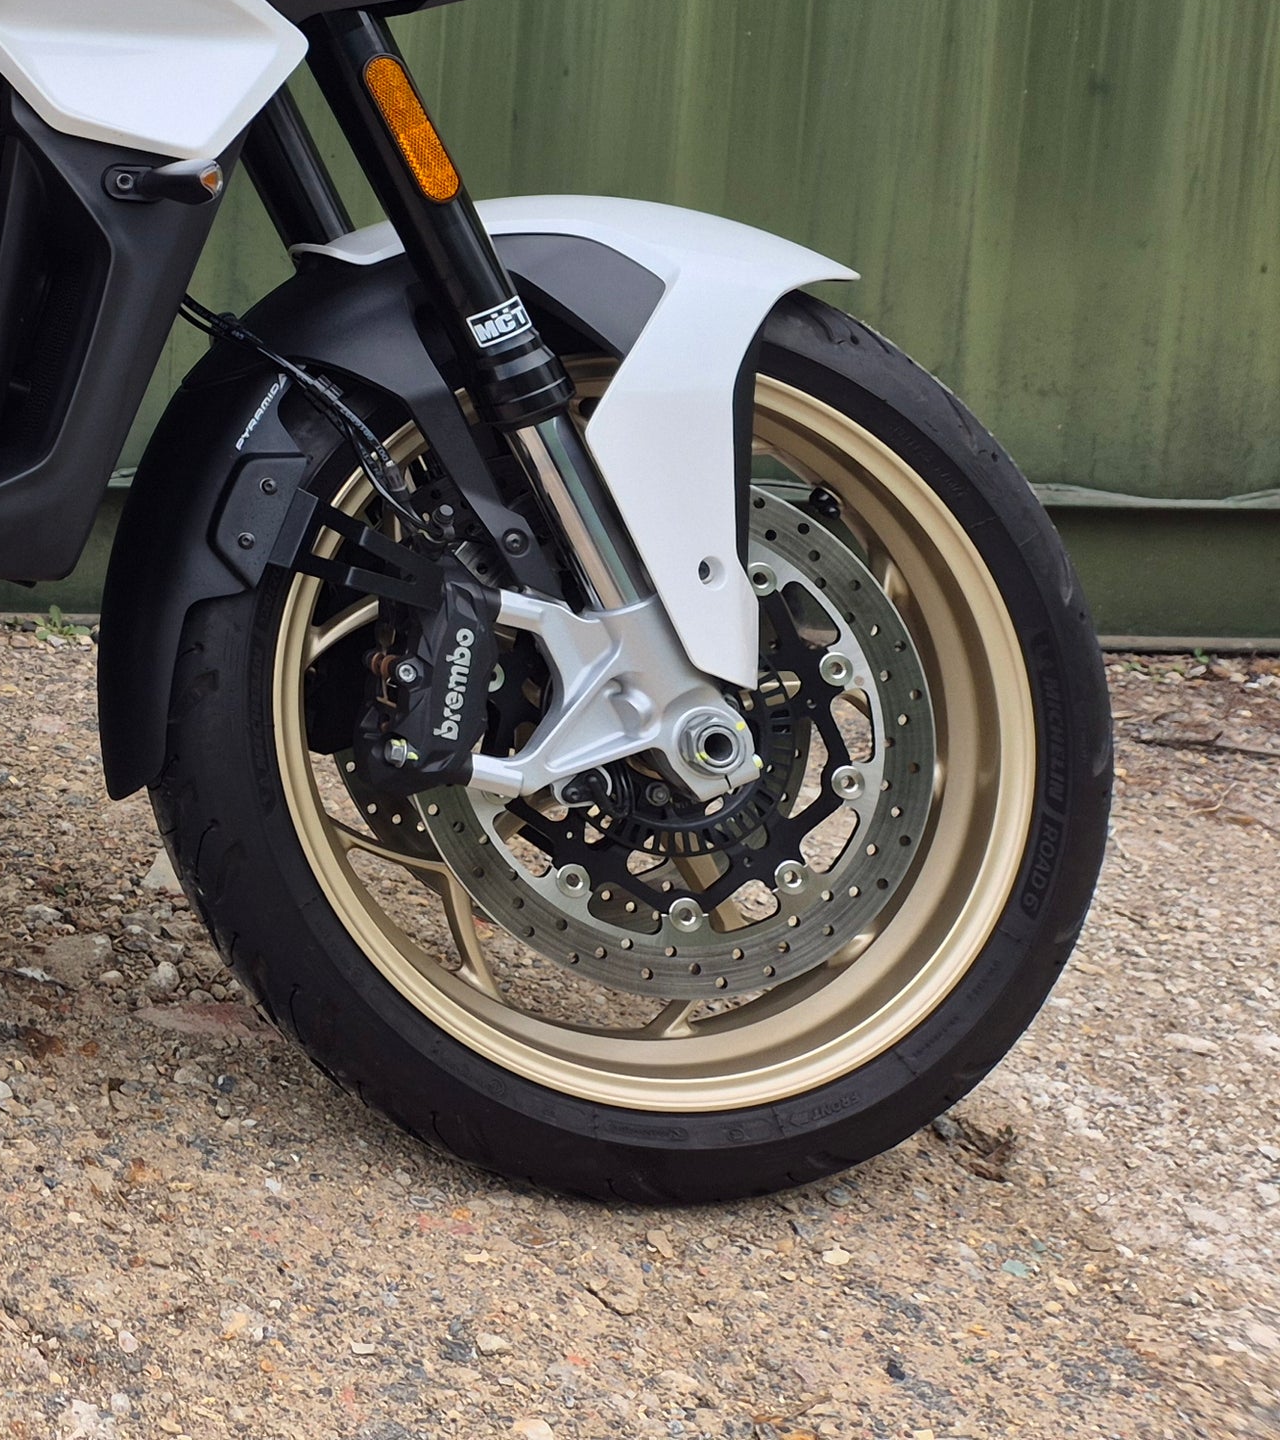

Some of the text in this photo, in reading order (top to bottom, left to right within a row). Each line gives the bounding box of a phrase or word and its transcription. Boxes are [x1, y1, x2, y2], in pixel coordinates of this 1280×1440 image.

[235, 381, 281, 452] PYRAMID
[432, 627, 476, 741] brembo
[1022, 675, 1066, 912] MICHELIN ROAD 6
[811, 1091, 860, 1121] FRONT
